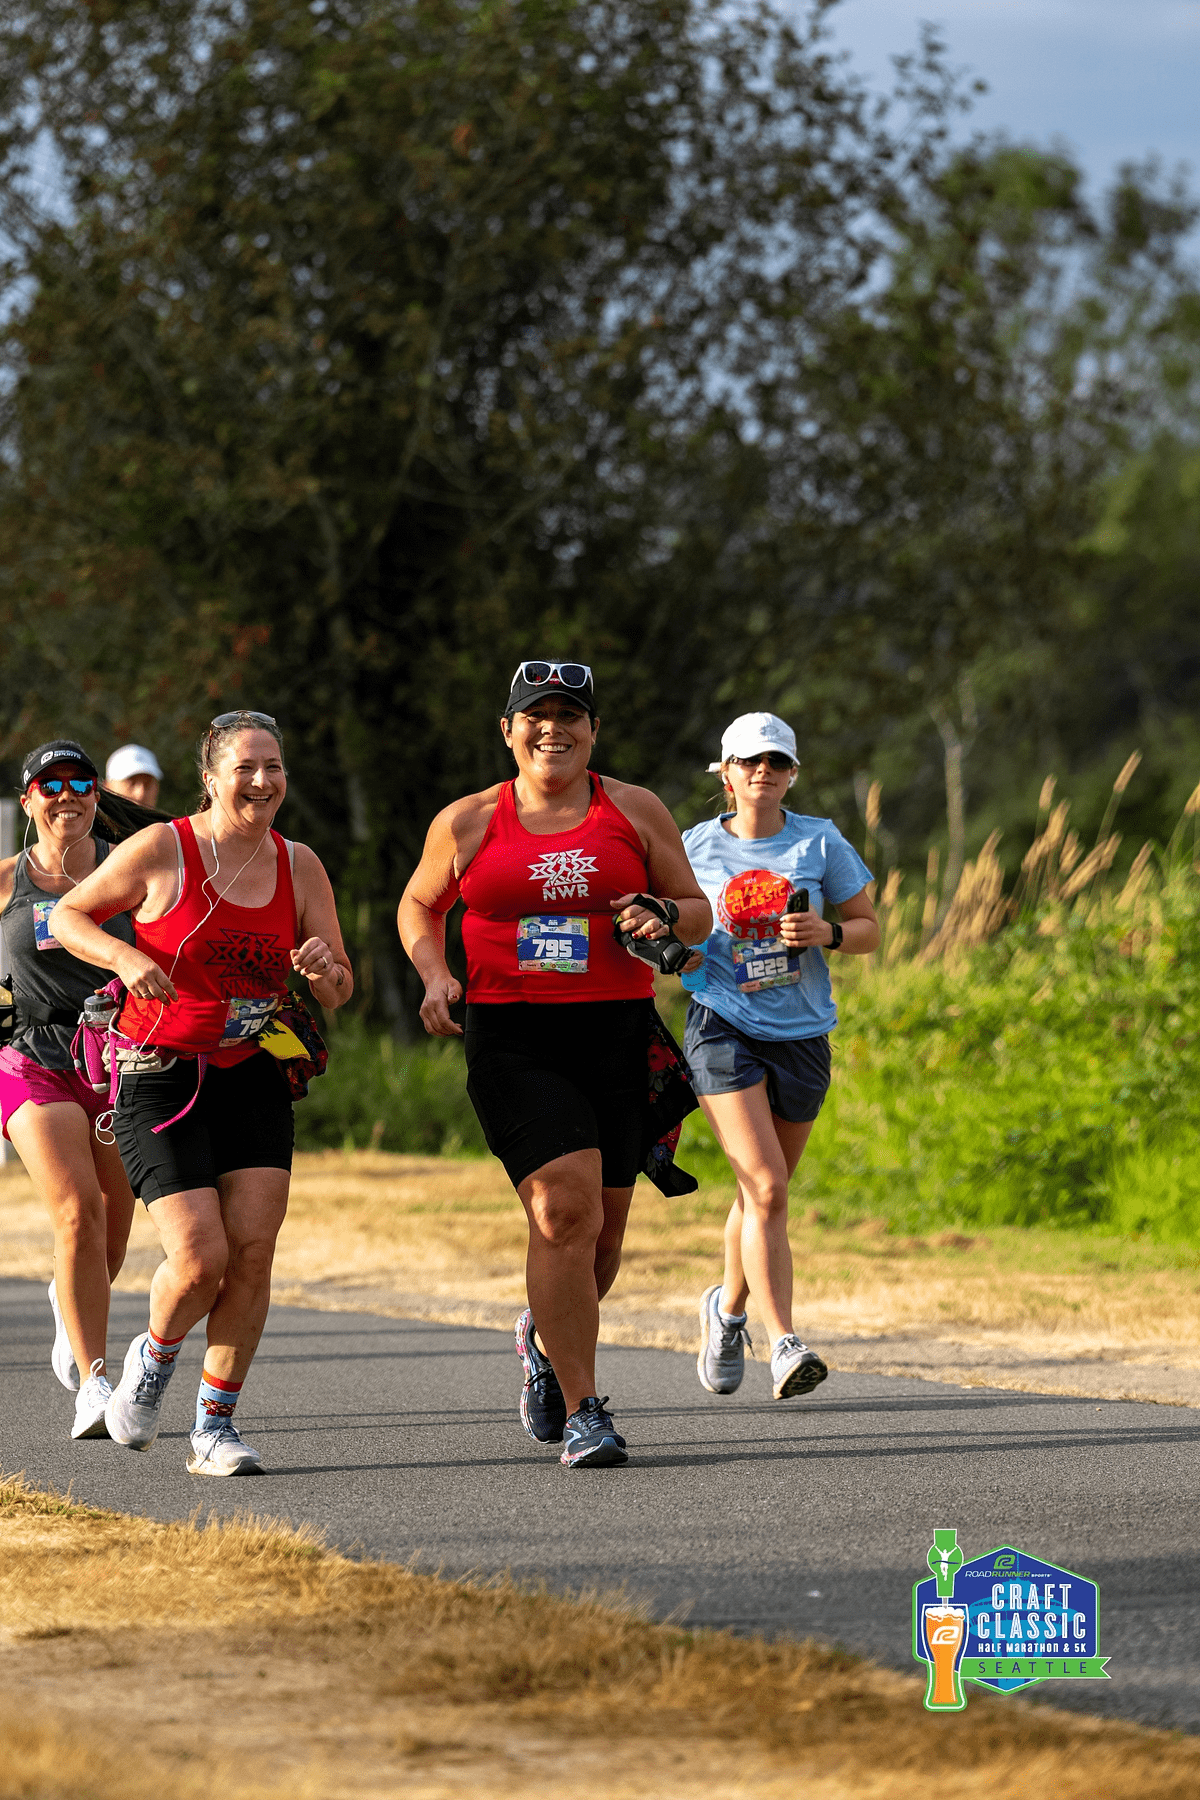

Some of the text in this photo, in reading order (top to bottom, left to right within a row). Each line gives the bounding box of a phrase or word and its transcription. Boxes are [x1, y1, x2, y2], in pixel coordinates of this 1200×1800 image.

[542, 883, 590, 902] NWR
[725, 882, 769, 904] CRAFT
[731, 885, 785, 914] CLASSIC
[532, 939, 573, 957] 795
[746, 956, 788, 979] 1229
